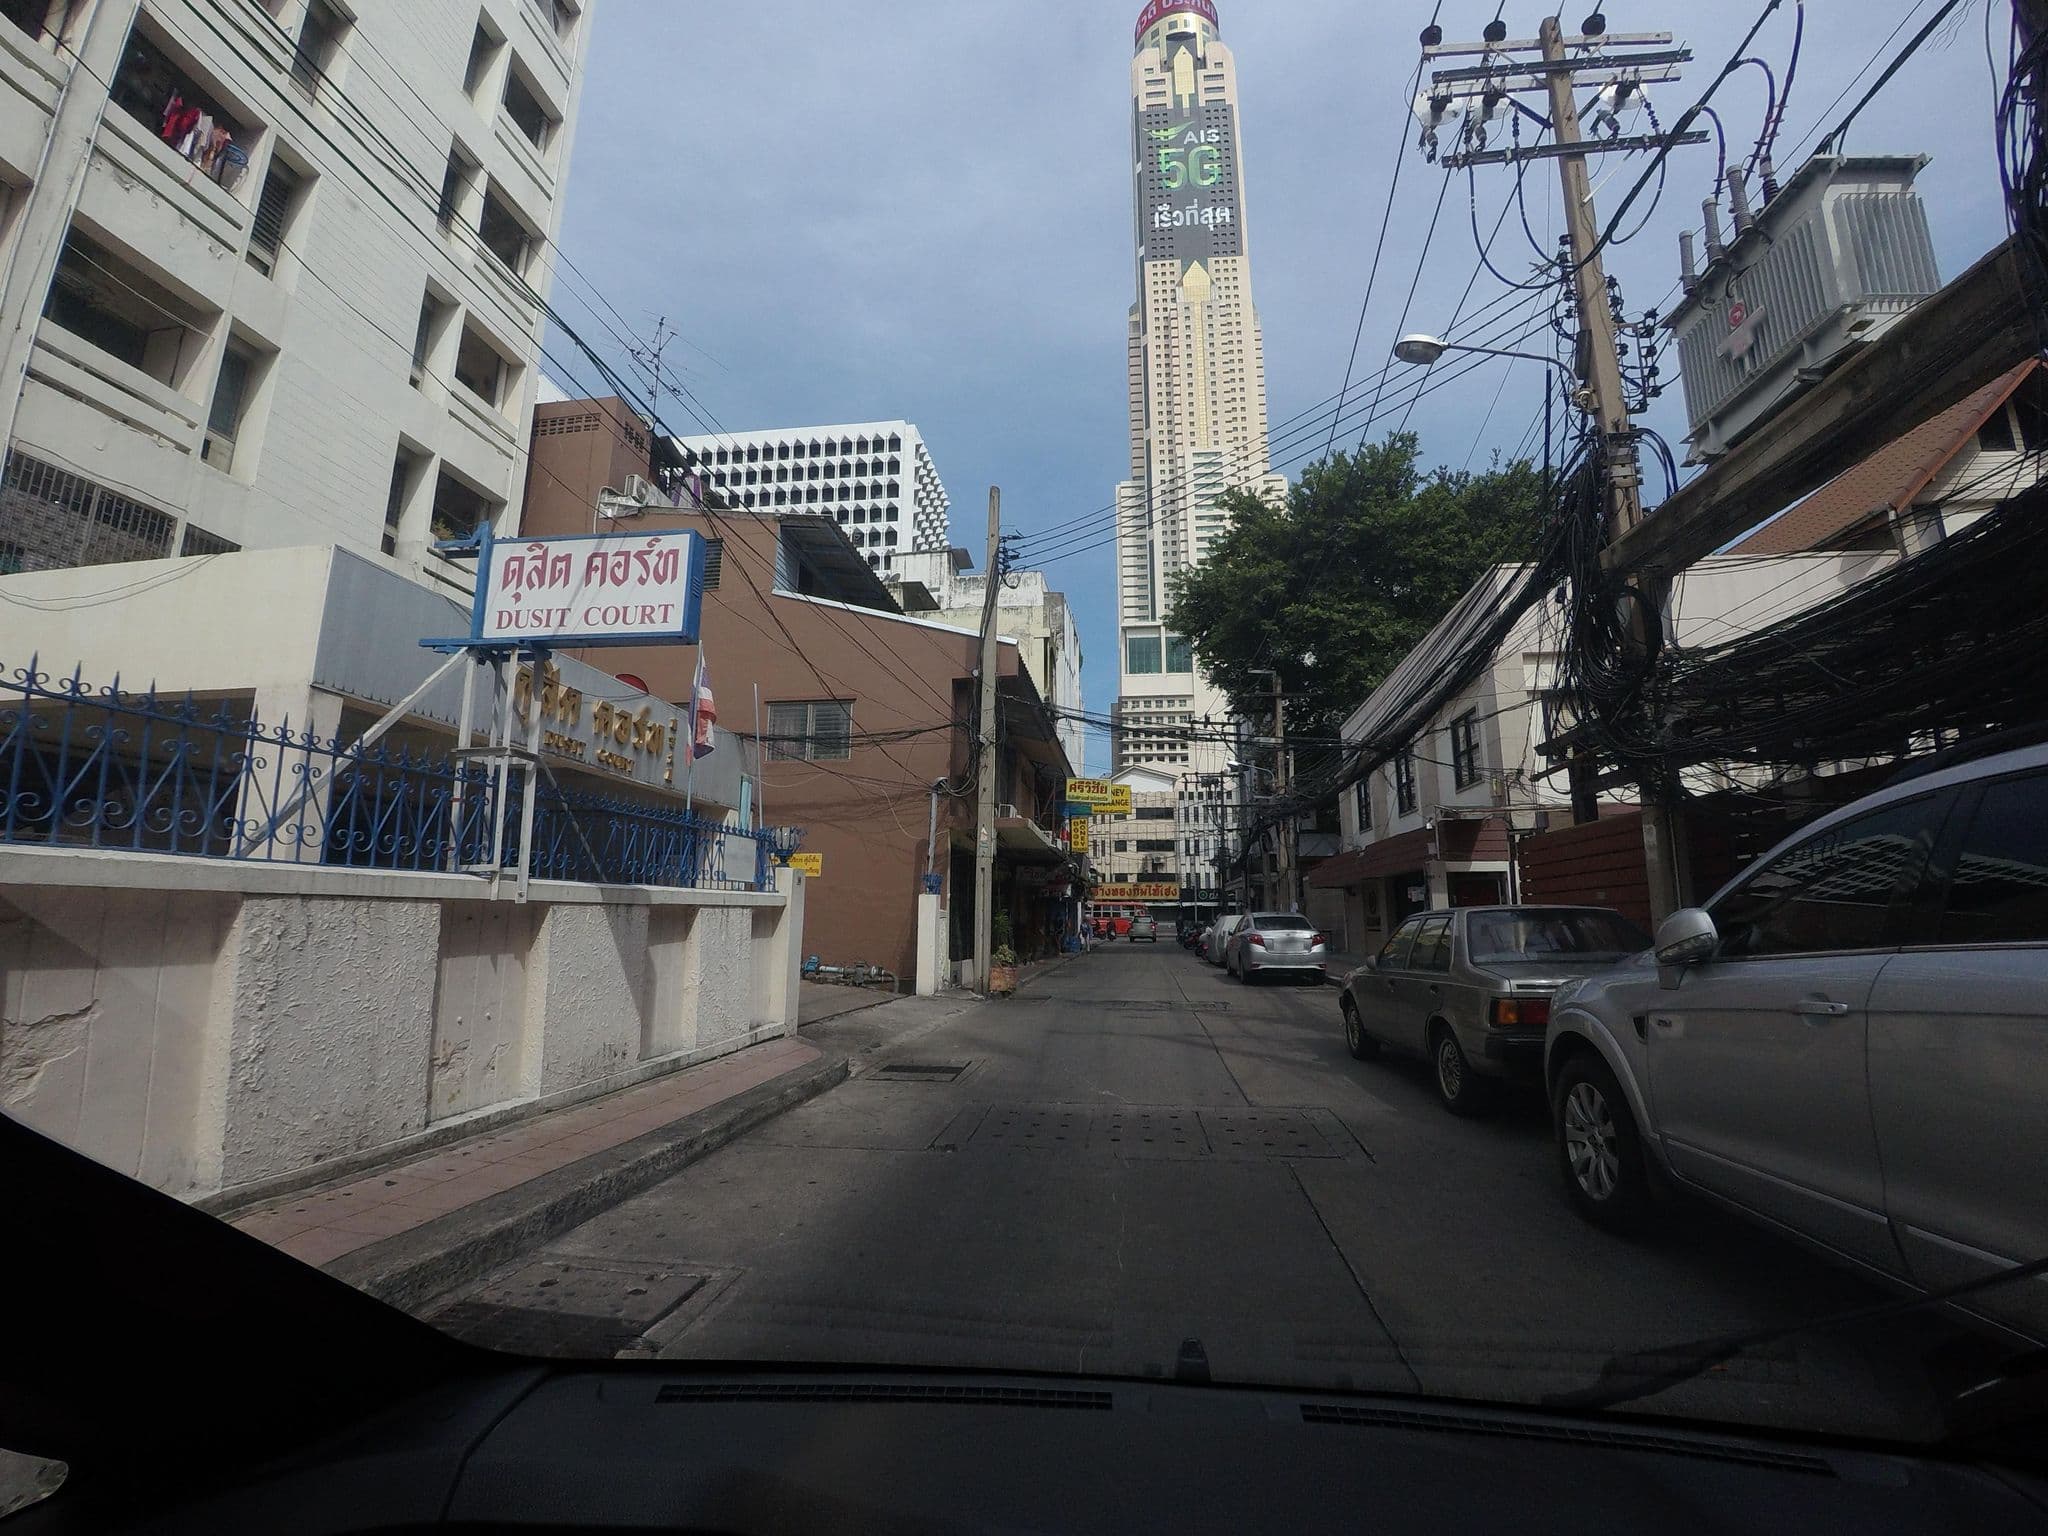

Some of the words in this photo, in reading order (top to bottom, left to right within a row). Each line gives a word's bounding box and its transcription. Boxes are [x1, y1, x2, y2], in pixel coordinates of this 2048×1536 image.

[1184, 129, 1220, 144] AIS
[1159, 146, 1222, 190] 5G
[1155, 199, 1231, 231] เร็วที่สุด
[502, 542, 572, 604] ดุสิต
[584, 537, 680, 588] คอร์ท
[495, 608, 571, 629] DUSIT
[583, 604, 674, 626] COURT
